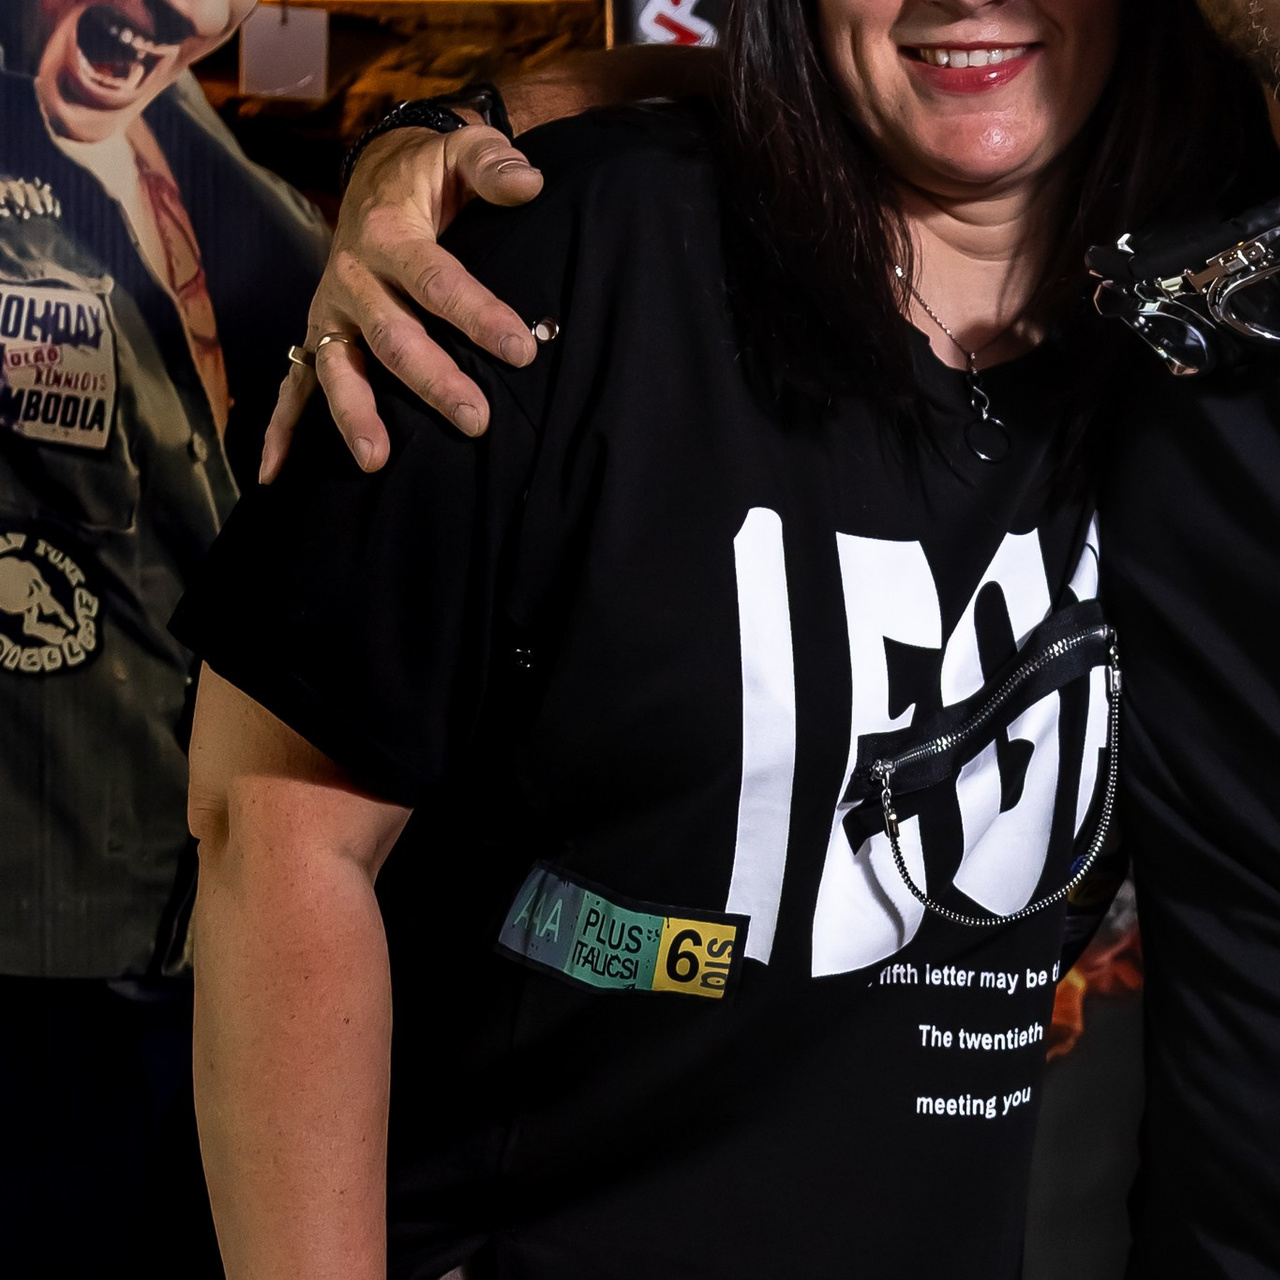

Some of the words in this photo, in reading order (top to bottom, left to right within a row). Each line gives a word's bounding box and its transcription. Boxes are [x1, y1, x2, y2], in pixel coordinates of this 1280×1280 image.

[513, 887, 563, 943] AAA
[583, 907, 643, 954] PLUS
[666, 928, 703, 983] 6
[925, 963, 975, 988] letter
[980, 971, 1019, 995] may
[1026, 968, 1047, 988] be
[919, 1024, 953, 1048] The
[958, 1022, 1043, 1050] twentieth
[916, 1093, 997, 1119] meeting
[1002, 1086, 1031, 1116] you
